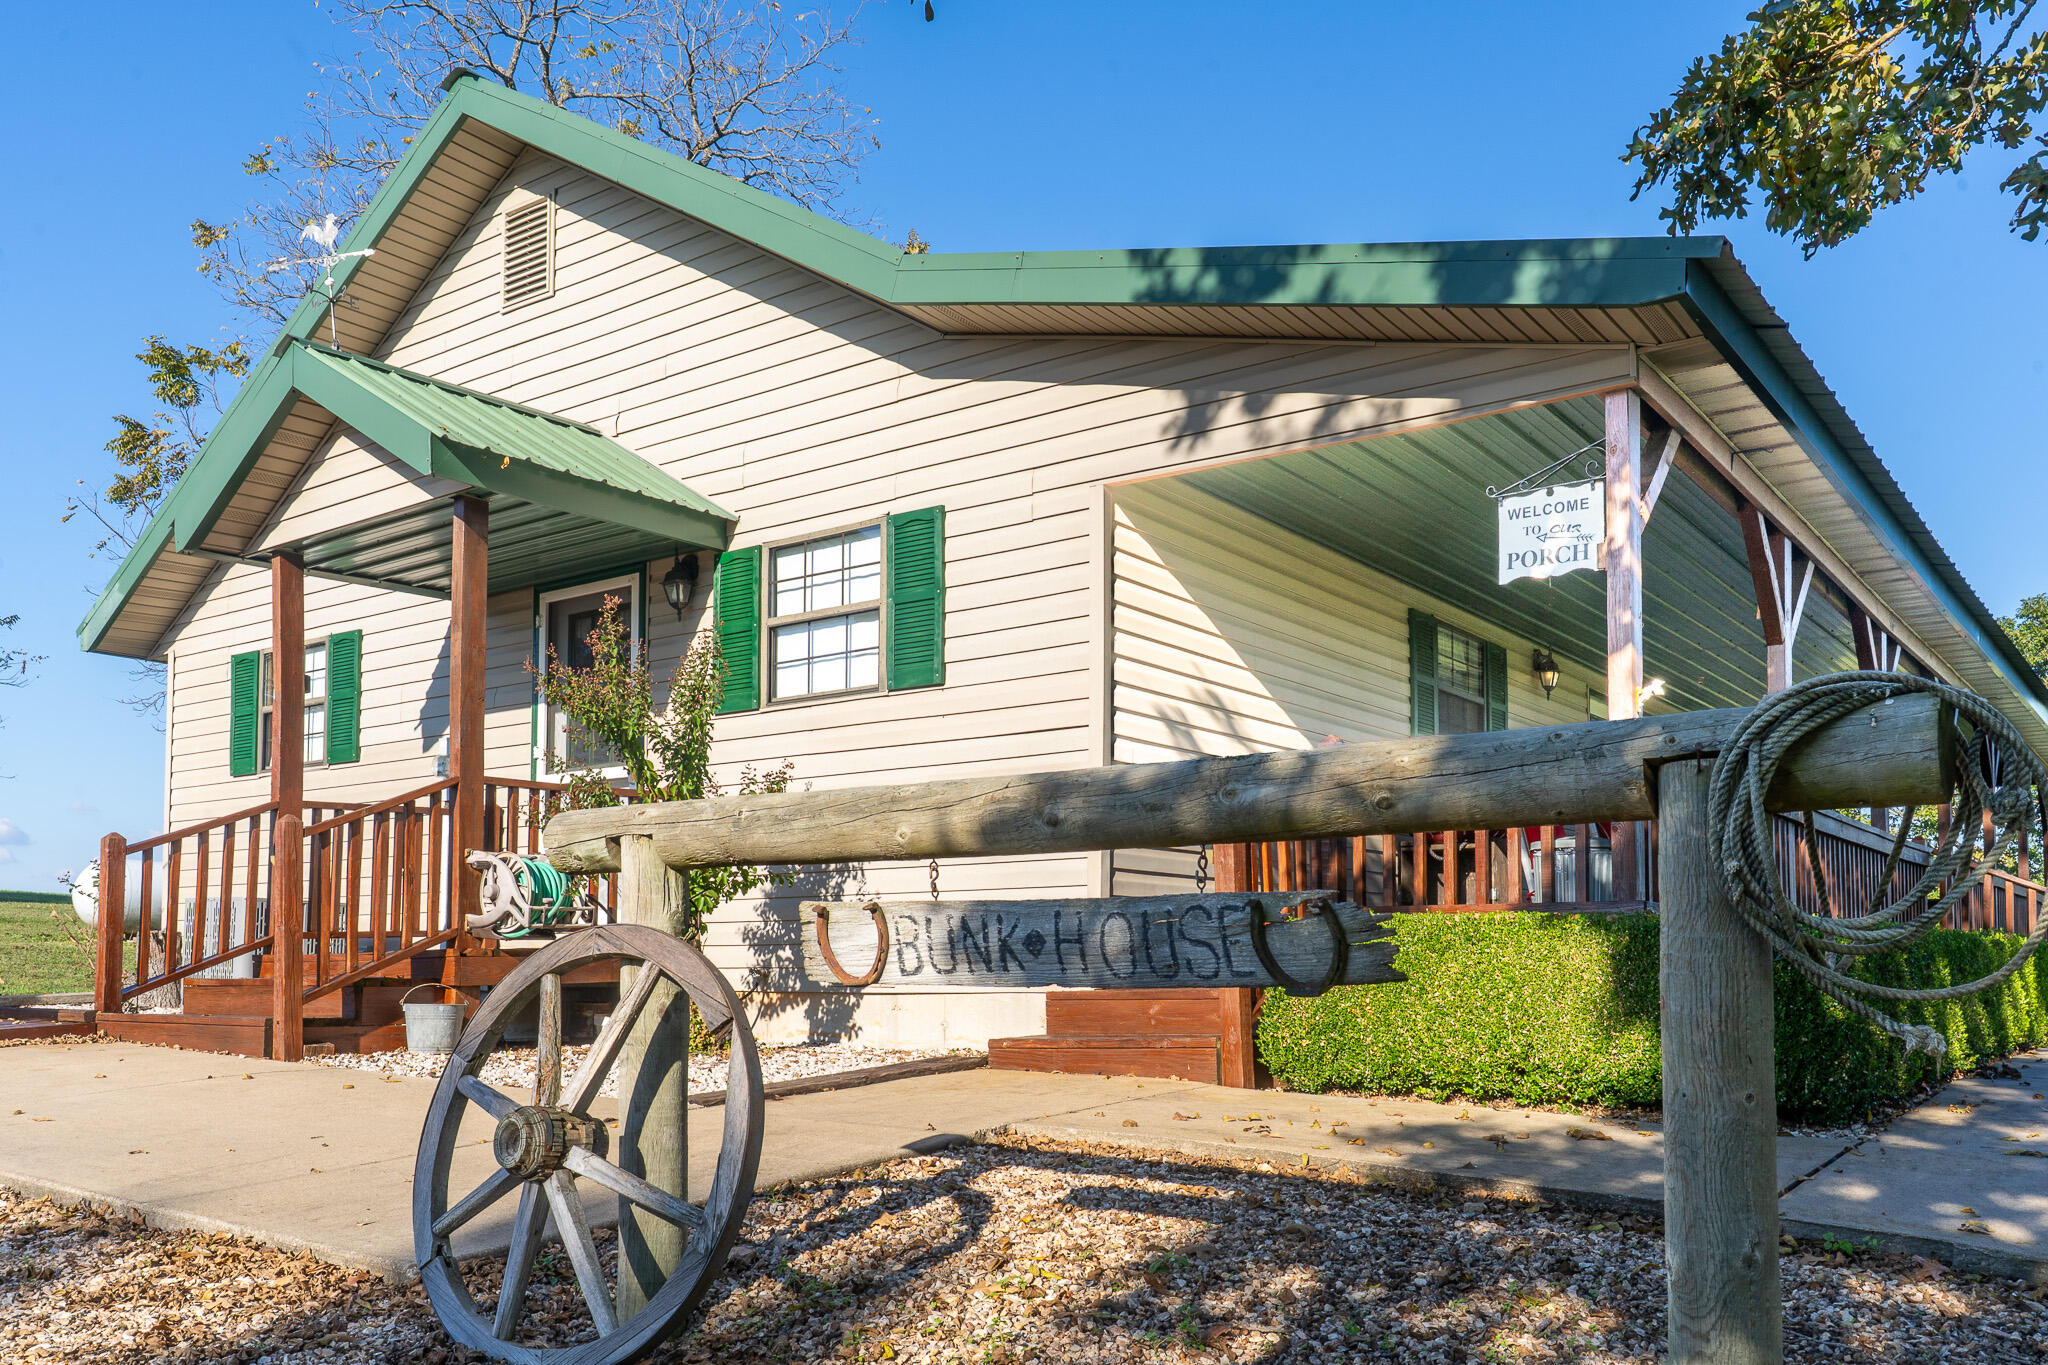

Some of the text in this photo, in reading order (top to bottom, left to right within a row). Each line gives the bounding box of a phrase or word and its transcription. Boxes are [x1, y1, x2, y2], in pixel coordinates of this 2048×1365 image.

[1508, 498, 1590, 521] WELCOME
[1522, 525, 1542, 536] TO
[1506, 543, 1589, 570] PORCH
[894, 903, 1256, 980] BUNK HOUSE
